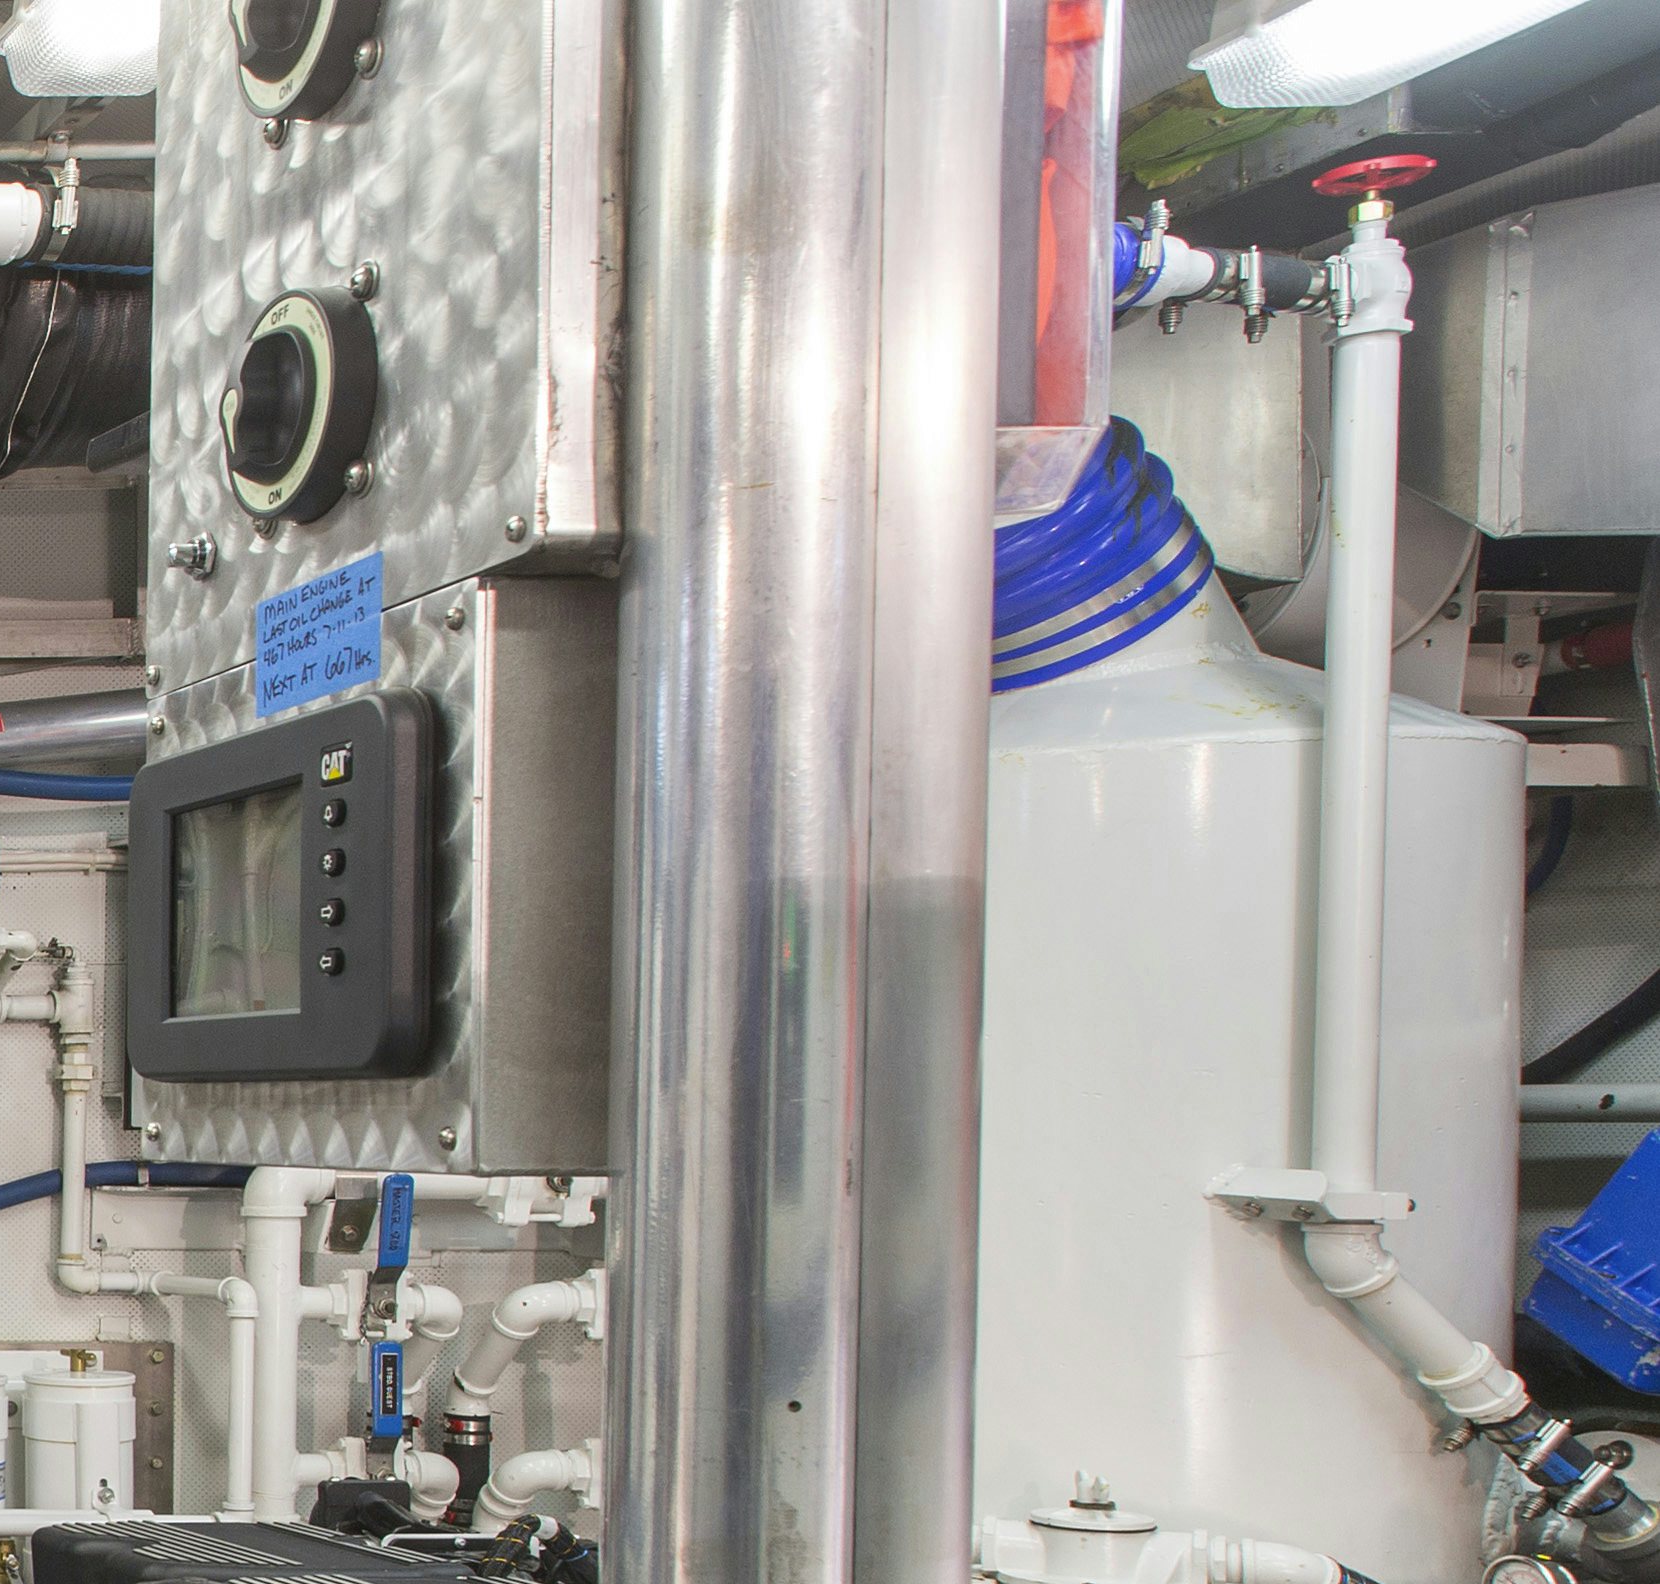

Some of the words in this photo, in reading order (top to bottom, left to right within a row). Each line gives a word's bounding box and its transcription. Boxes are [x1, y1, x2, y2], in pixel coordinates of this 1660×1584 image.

[279, 79, 294, 100] ON
[271, 304, 290, 326] OFF
[268, 488, 283, 505] ON
[263, 619, 289, 643] LAST
[289, 613, 309, 632] OIL
[309, 589, 353, 622] CHANGE
[358, 576, 376, 596] AT
[264, 594, 297, 625] MAIN
[301, 571, 351, 603] ENGINE
[263, 643, 285, 667] 467
[263, 674, 297, 708] NEXT
[300, 662, 318, 686] AT
[324, 646, 352, 680] 667
[321, 749, 348, 781] CAT
[386, 1387, 394, 1409] GUEST
